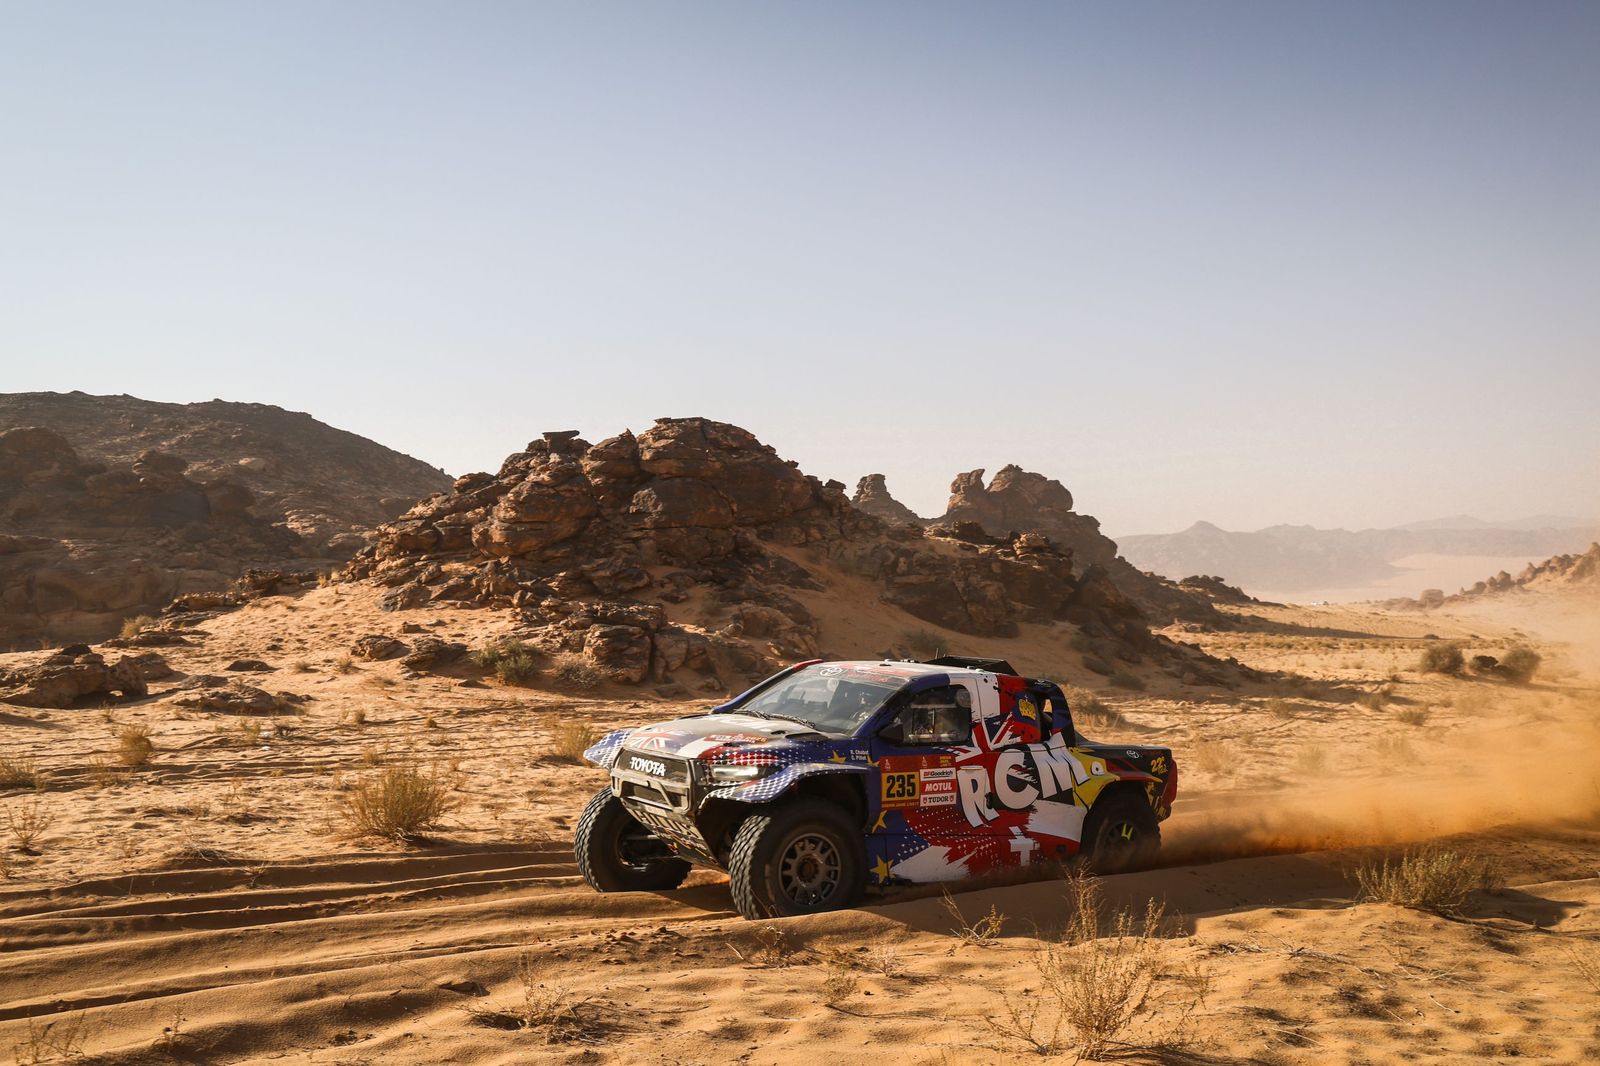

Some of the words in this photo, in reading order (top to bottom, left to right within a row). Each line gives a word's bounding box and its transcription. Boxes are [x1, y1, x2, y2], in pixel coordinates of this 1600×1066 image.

[630, 757, 666, 777] TOYOTA
[886, 774, 916, 798] 235
[925, 782, 952, 792] MOTUL
[956, 731, 1090, 828] RCM
